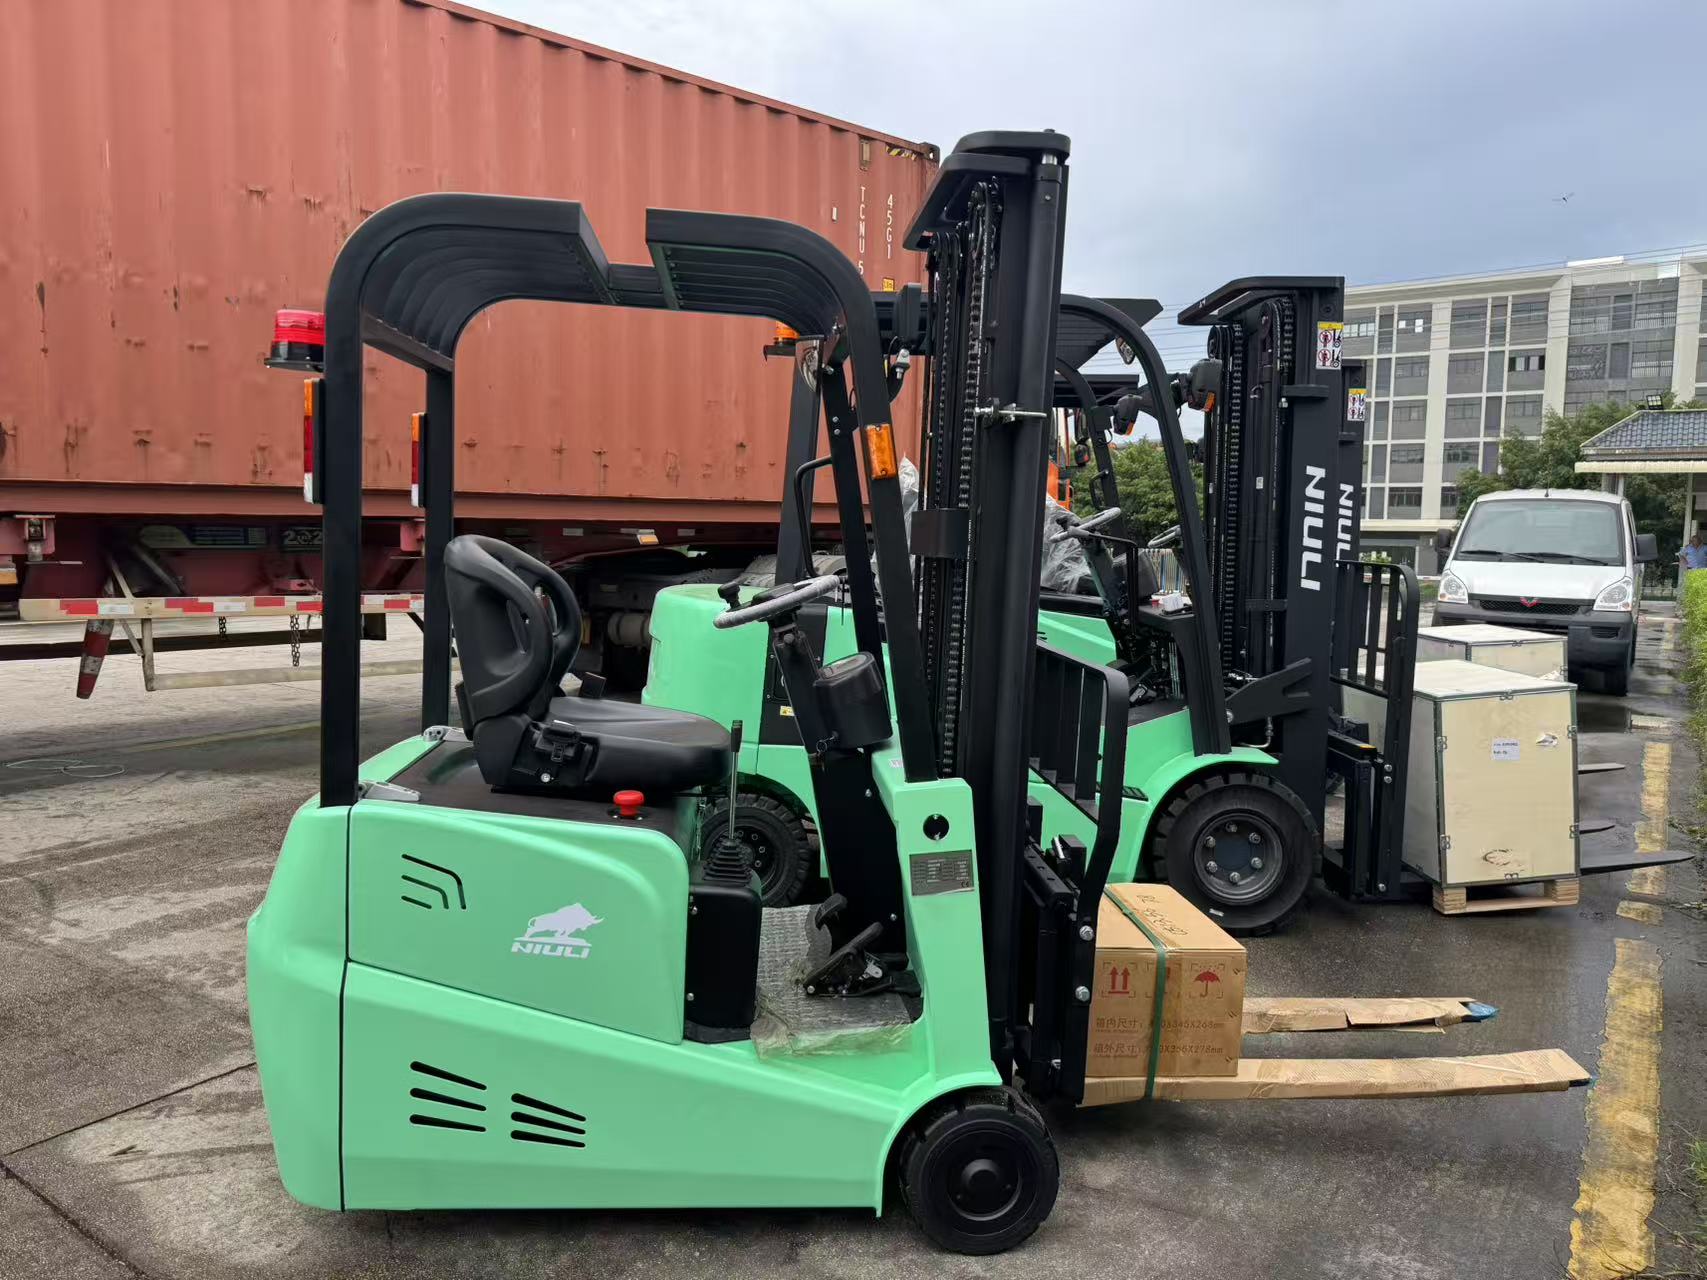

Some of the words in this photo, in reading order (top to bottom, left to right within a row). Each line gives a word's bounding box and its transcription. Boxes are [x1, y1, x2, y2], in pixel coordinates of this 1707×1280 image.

[886, 193, 894, 259] 45G1
[1300, 465, 1326, 591] NIULI
[511, 942, 590, 958] NIULI
